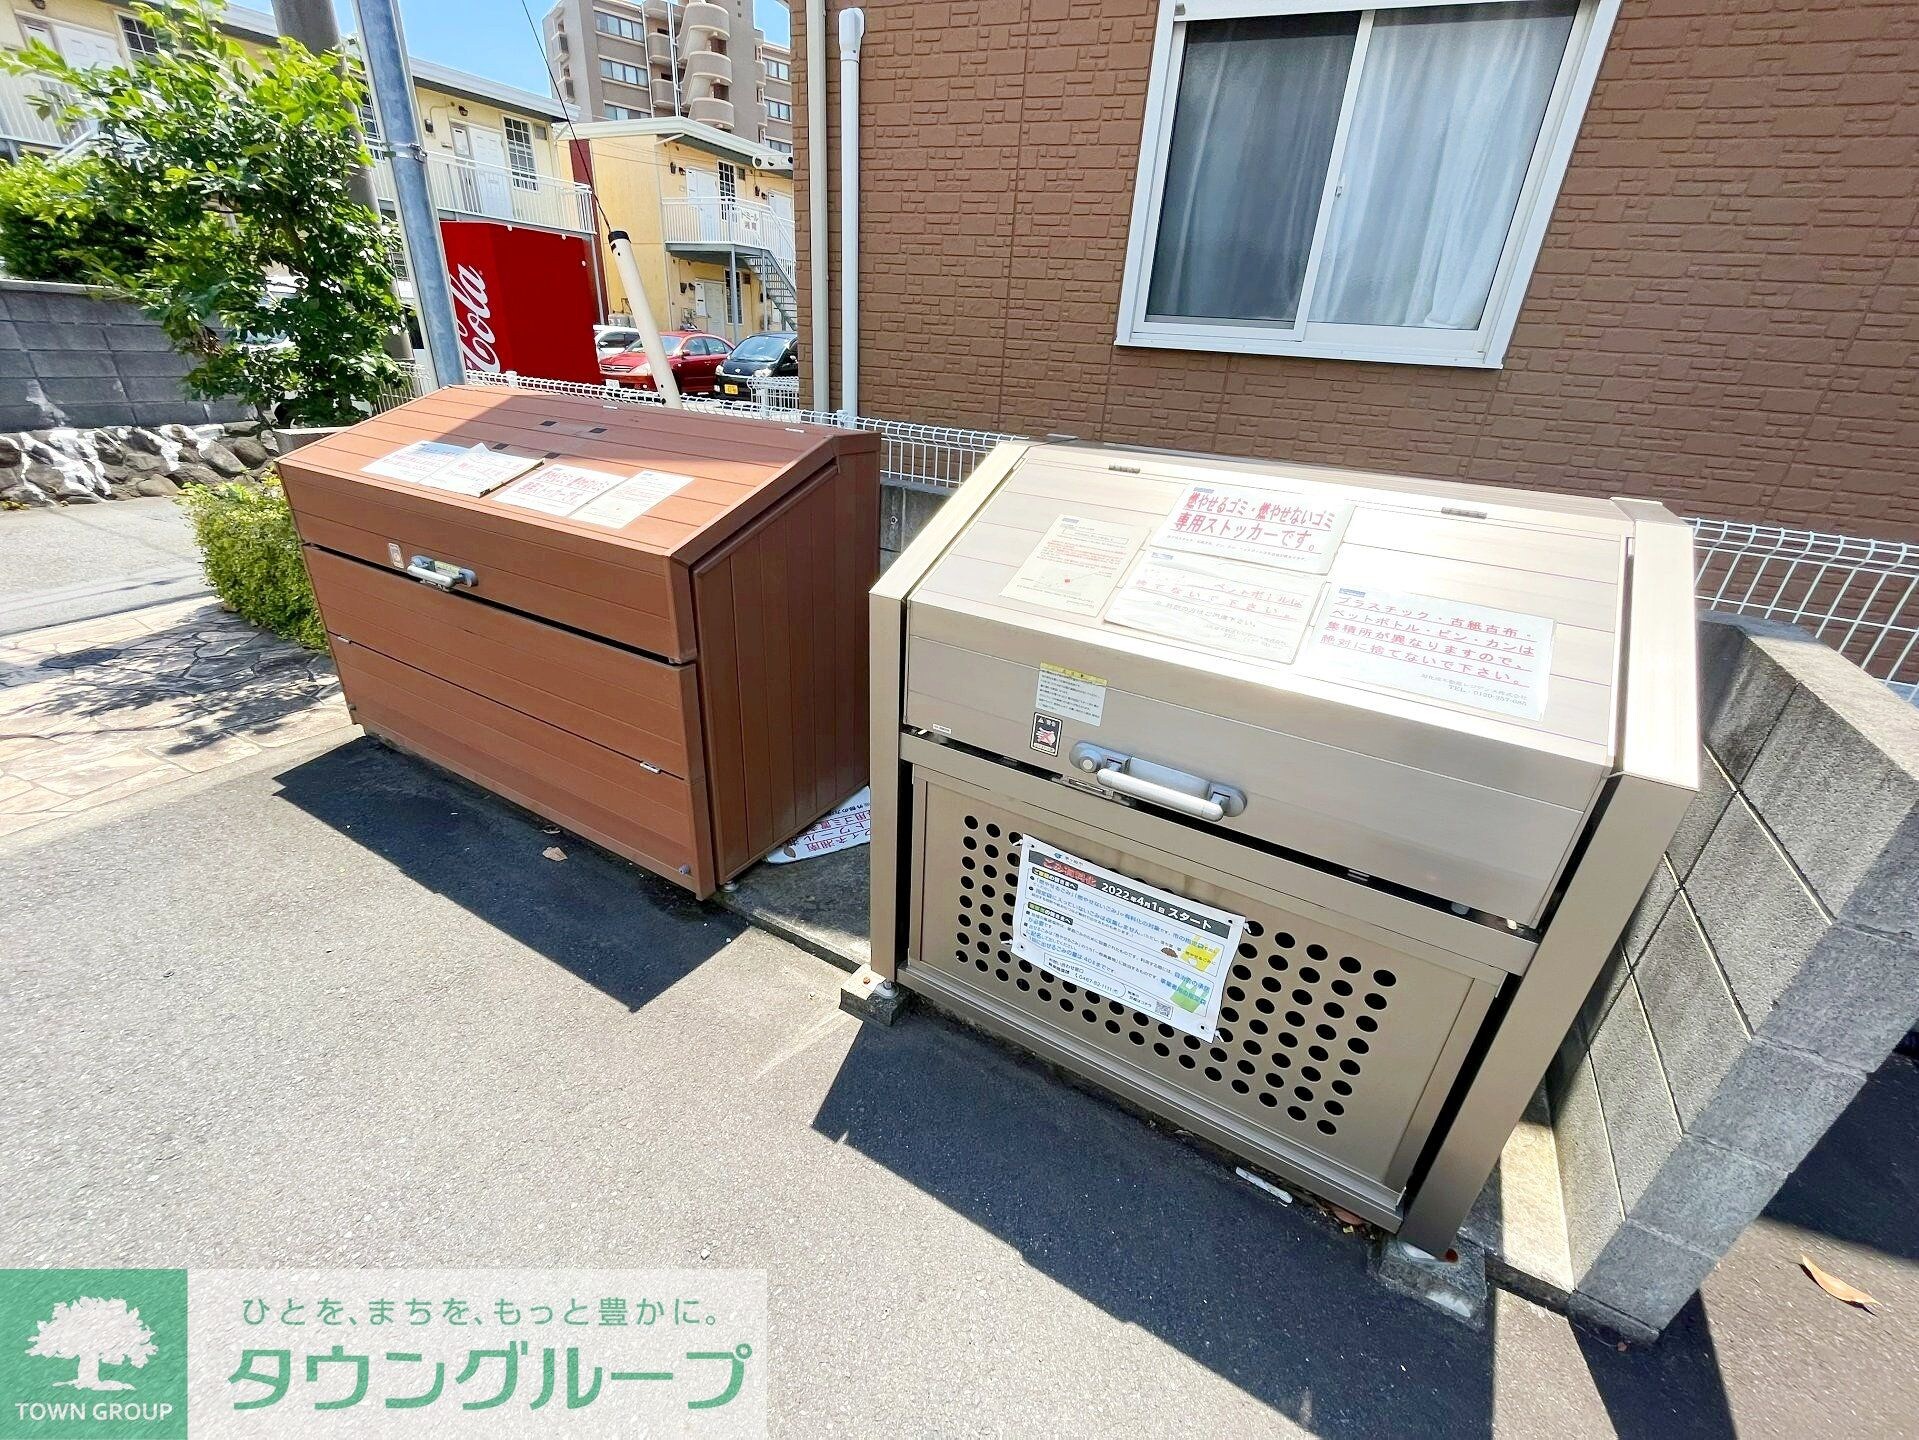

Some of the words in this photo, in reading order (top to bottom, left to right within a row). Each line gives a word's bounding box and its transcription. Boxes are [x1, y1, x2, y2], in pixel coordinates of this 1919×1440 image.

[450, 263, 501, 373] Cola
[1173, 511, 1316, 553] 専用ストッカーです。
[1183, 491, 1336, 530] 燃やせるゴミ・燃やせないゴミ
[1331, 608, 1536, 657] ペットボトル・ビン・カンは
[1338, 597, 1533, 638] プラスチック・古紙古布・
[1320, 634, 1522, 686] 絶対に捨てないで下さい。
[1327, 621, 1524, 671] 集積所が異なりますので、
[1100, 882, 1167, 914] 2022年4月1日
[1167, 907, 1213, 931] スタート
